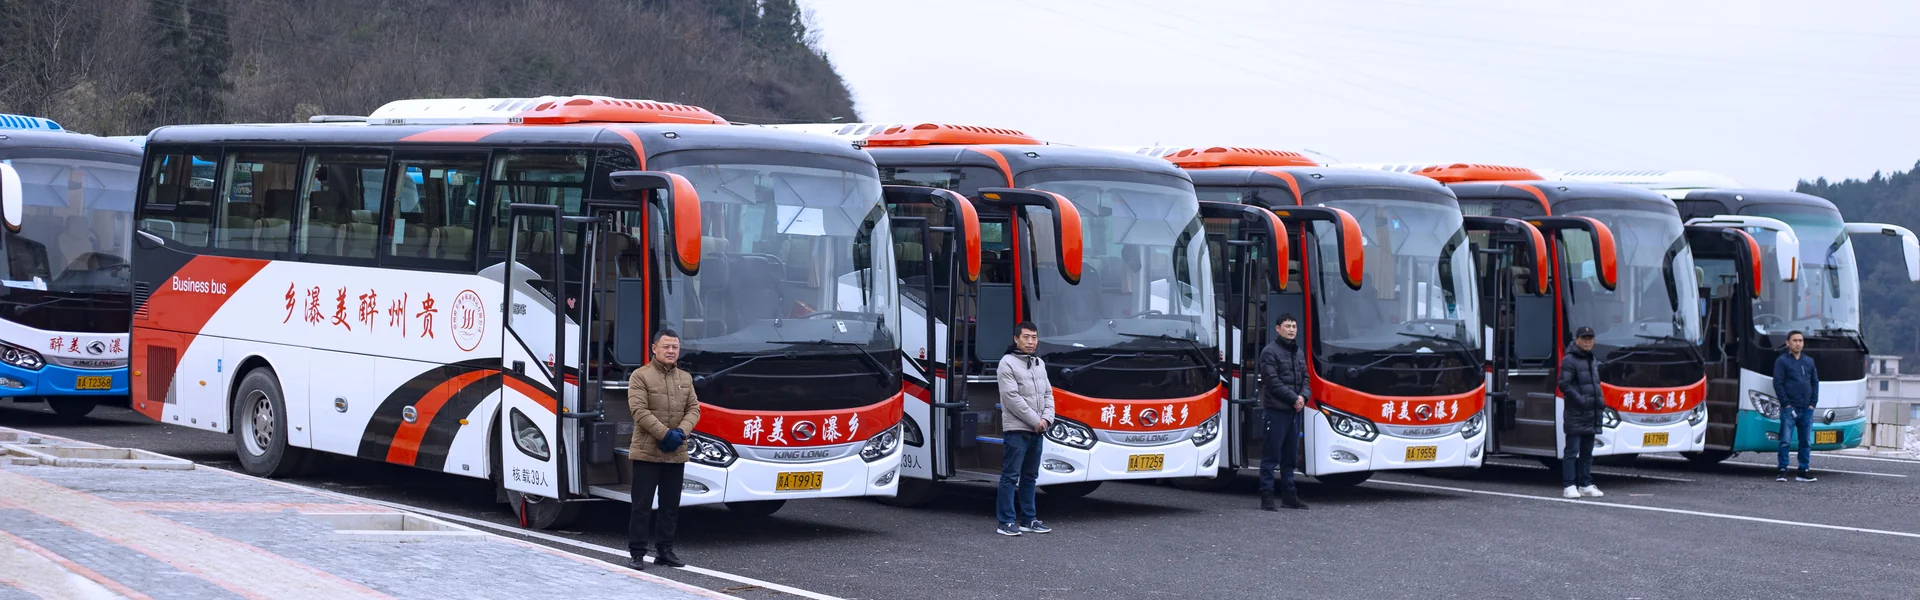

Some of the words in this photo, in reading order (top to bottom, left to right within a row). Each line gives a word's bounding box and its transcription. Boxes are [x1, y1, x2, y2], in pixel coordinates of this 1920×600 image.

[172, 276, 210, 293] Business
[211, 278, 227, 295] bus
[1125, 434, 1146, 443] KING
[1146, 434, 1169, 442] LONG
[773, 450, 800, 459] KING
[801, 449, 829, 459] LONG
